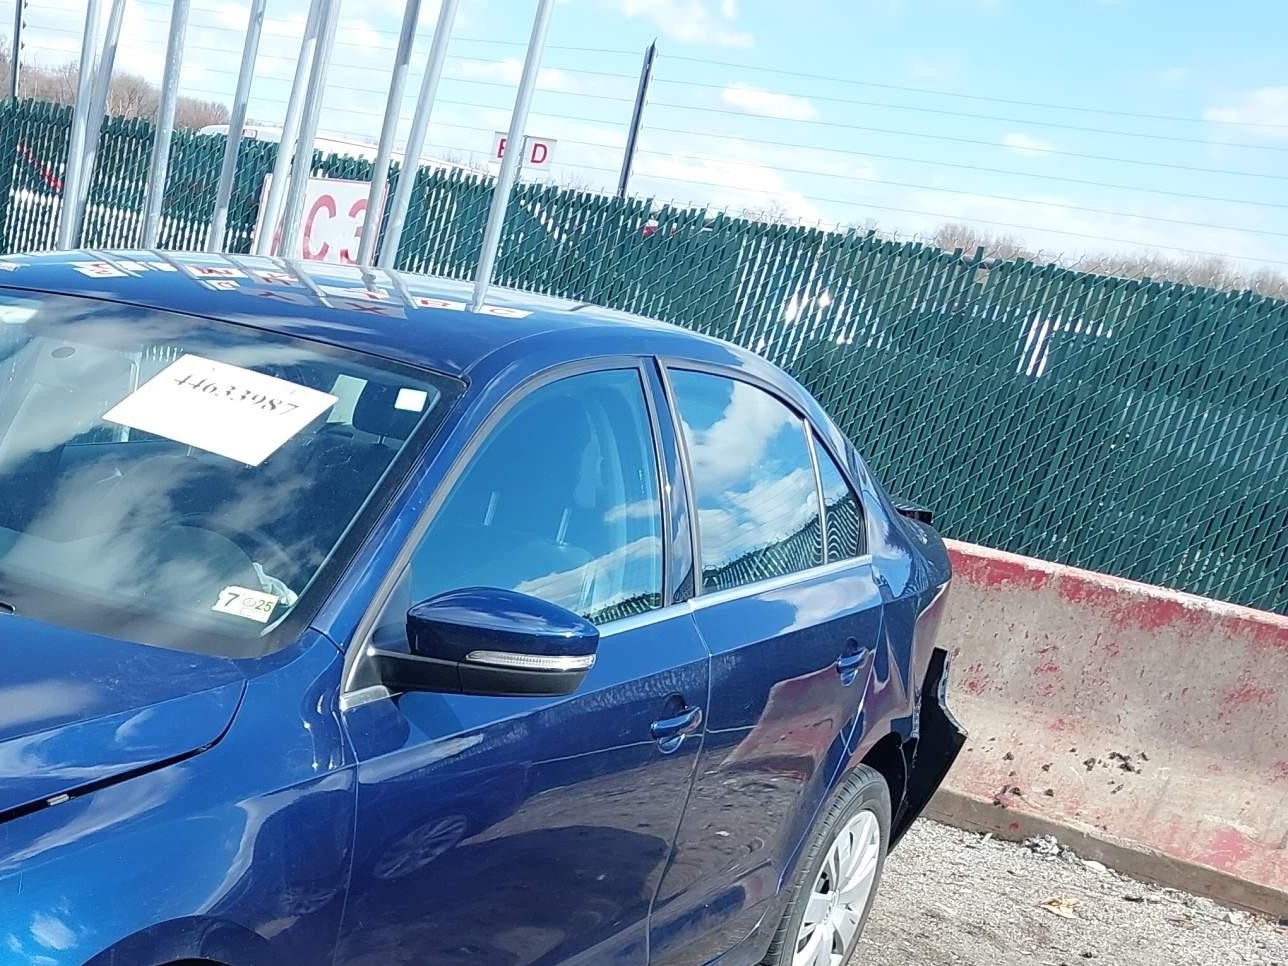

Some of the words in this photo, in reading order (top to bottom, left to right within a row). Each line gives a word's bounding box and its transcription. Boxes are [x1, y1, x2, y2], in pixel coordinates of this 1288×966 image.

[530, 143, 548, 164] D
[174, 373, 300, 415] 44633987
[224, 592, 240, 607] 7
[255, 599, 273, 613] 25
